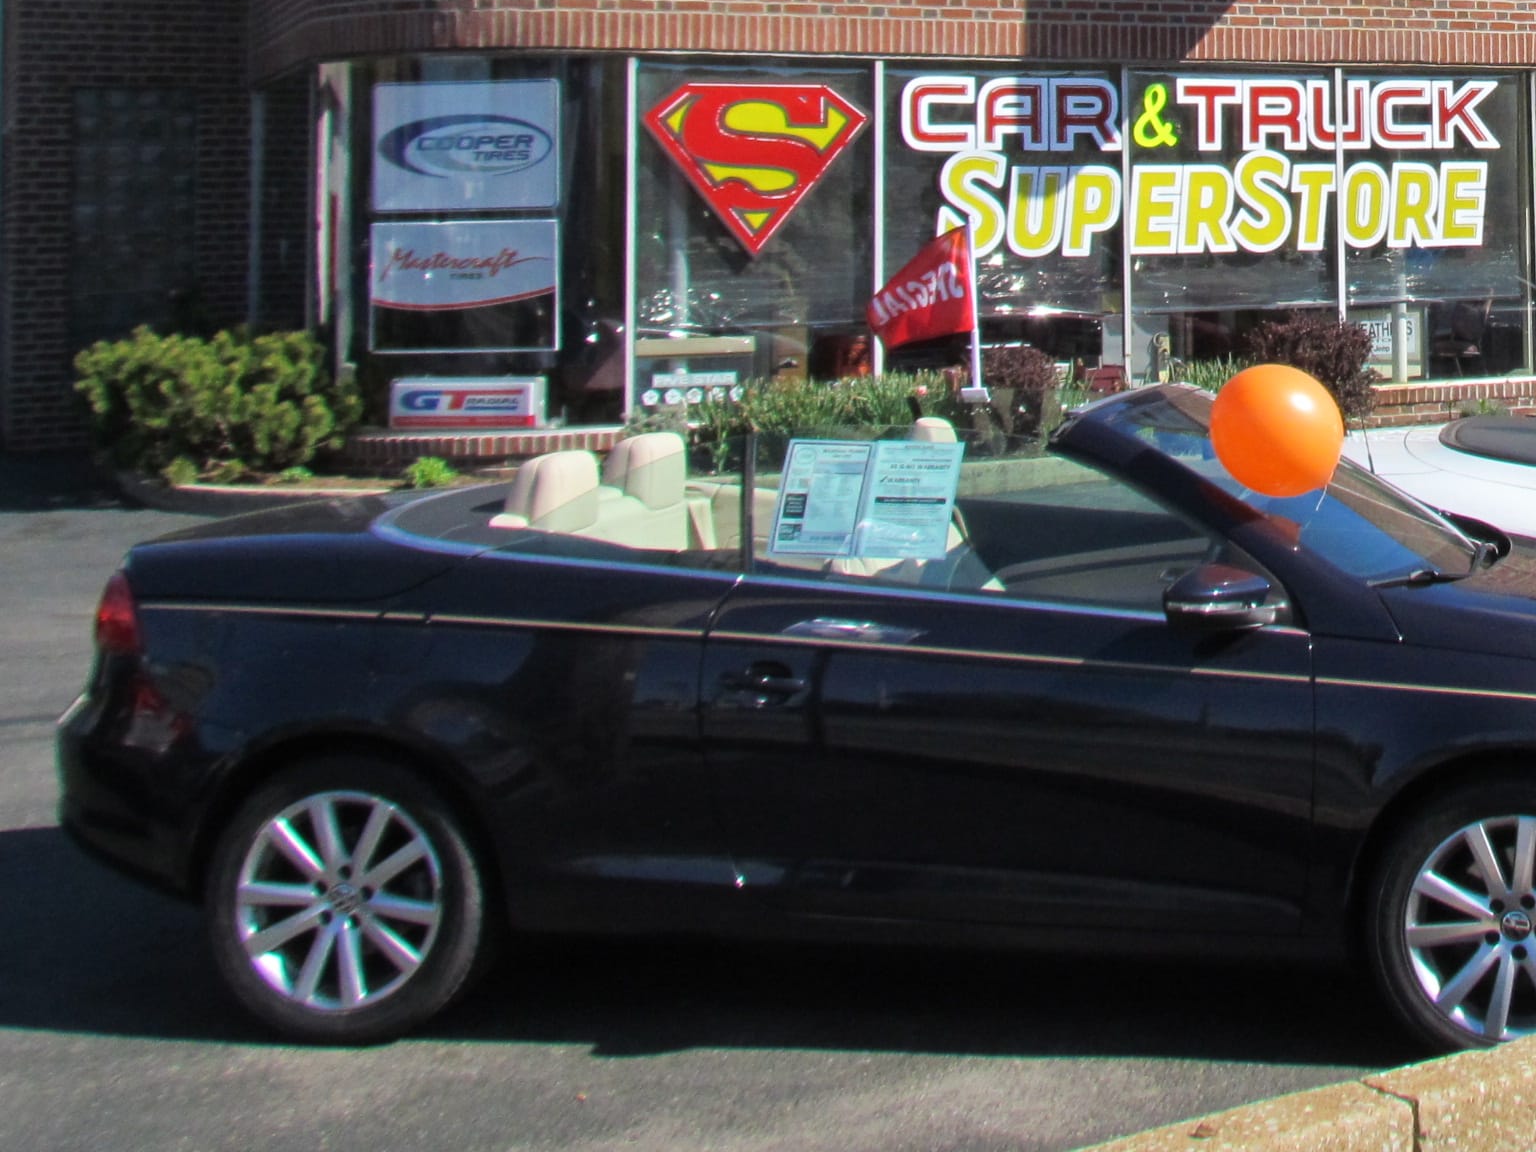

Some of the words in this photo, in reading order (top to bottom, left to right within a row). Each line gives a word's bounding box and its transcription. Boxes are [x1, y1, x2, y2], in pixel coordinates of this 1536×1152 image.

[901, 76, 1124, 151] CAR
[1132, 81, 1177, 148] &
[1176, 78, 1500, 150] TRUCK
[417, 134, 535, 151] COOPER
[474, 150, 531, 162] TIRES
[379, 246, 545, 282] Mastercraft
[402, 389, 482, 410] GT
